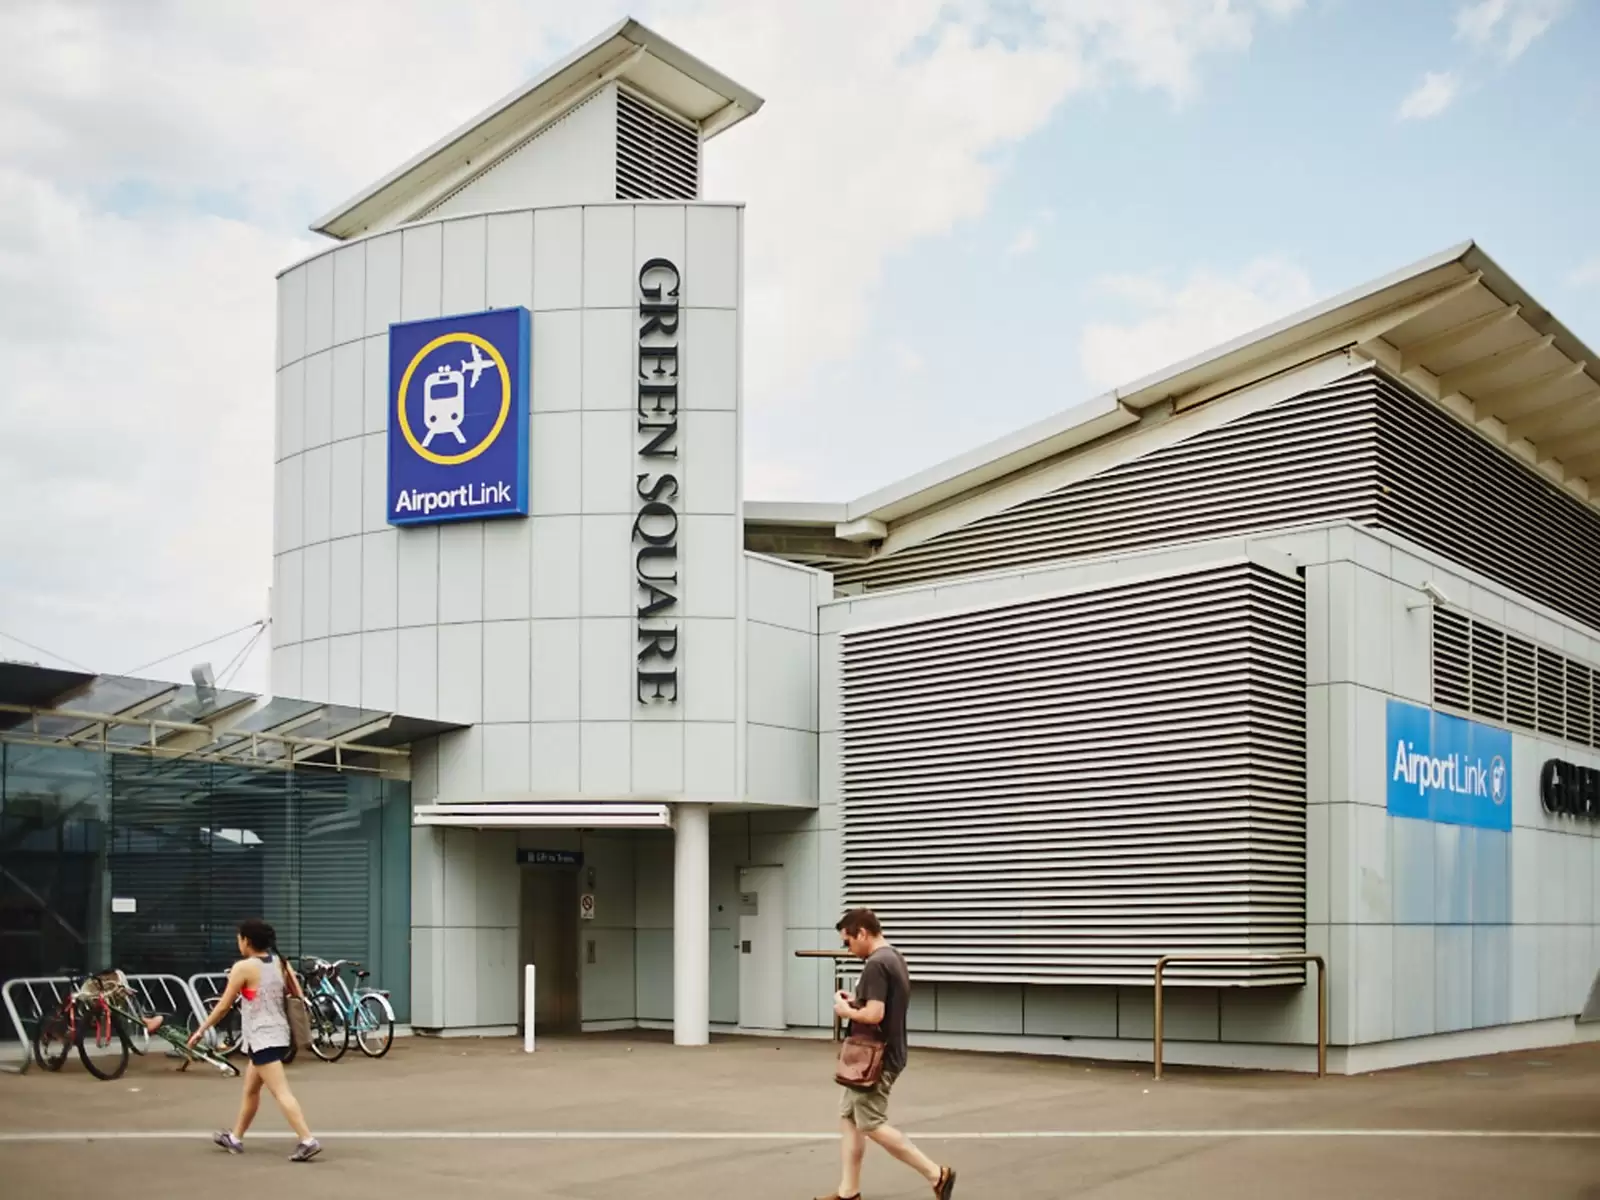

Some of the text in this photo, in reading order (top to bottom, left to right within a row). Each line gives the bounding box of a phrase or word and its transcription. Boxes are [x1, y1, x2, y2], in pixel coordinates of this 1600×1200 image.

[395, 480, 512, 515] AirportLink
[632, 257, 681, 705] GREEN SQUARE
[1392, 739, 1488, 798] AirportLink
